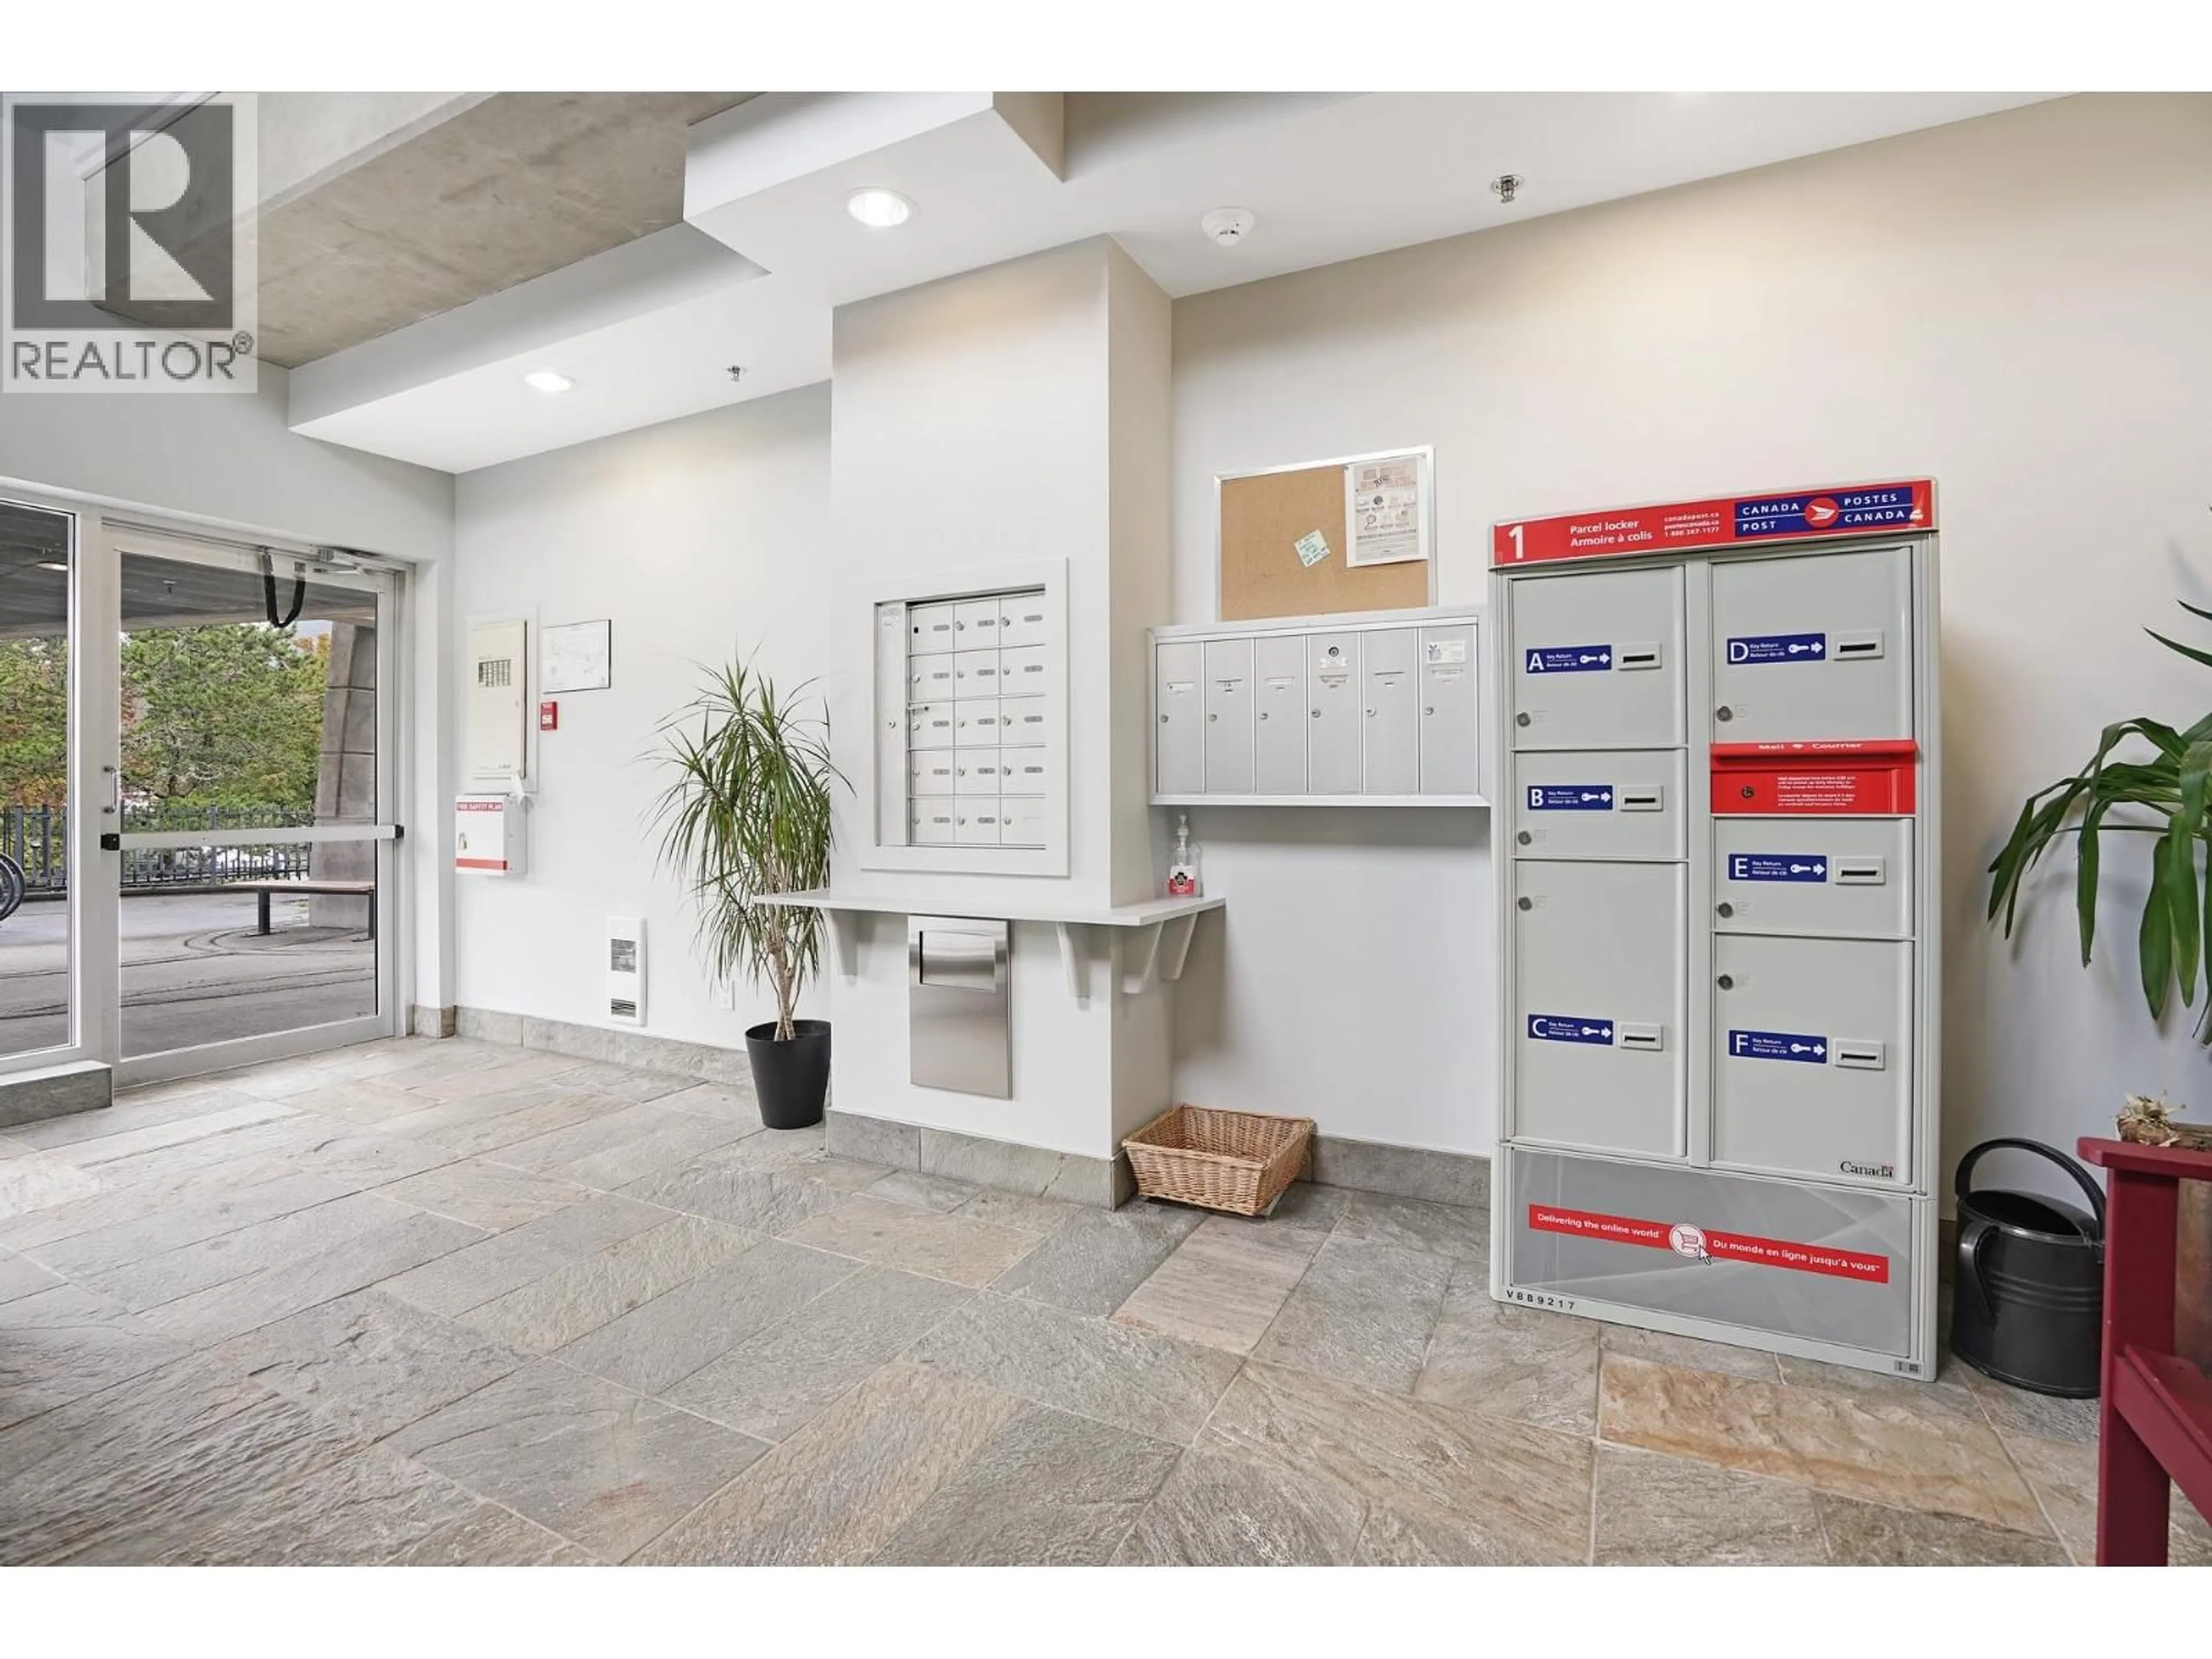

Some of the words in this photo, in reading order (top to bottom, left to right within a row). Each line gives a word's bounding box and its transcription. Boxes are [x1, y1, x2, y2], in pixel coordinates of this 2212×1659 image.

[1743, 502, 1800, 516] CANADA
[1844, 493, 1897, 506] POSTES
[1844, 509, 1905, 522] CANADA
[1570, 522, 1602, 535] Parcel
[1605, 520, 1639, 531] locker
[1743, 521, 1777, 531] POST
[1508, 525, 1525, 560] 1
[1570, 535, 1615, 547] Armoire
[1618, 533, 1624, 543] à
[1627, 531, 1653, 541] colis
[1528, 652, 1544, 671] A
[1730, 642, 1749, 662] D
[1531, 788, 1544, 807] B
[1735, 858, 1749, 877] E
[1532, 1018, 1547, 1037] C
[1736, 1033, 1748, 1054] F
[1840, 1161, 1892, 1177] Canada
[1537, 1213, 1582, 1228] Delivering
[1584, 1219, 1599, 1229] the
[1601, 1222, 1630, 1234] online
[1713, 1239, 1727, 1249] Du
[1729, 1243, 1764, 1255] monde
[1782, 1249, 1807, 1262] ligne
